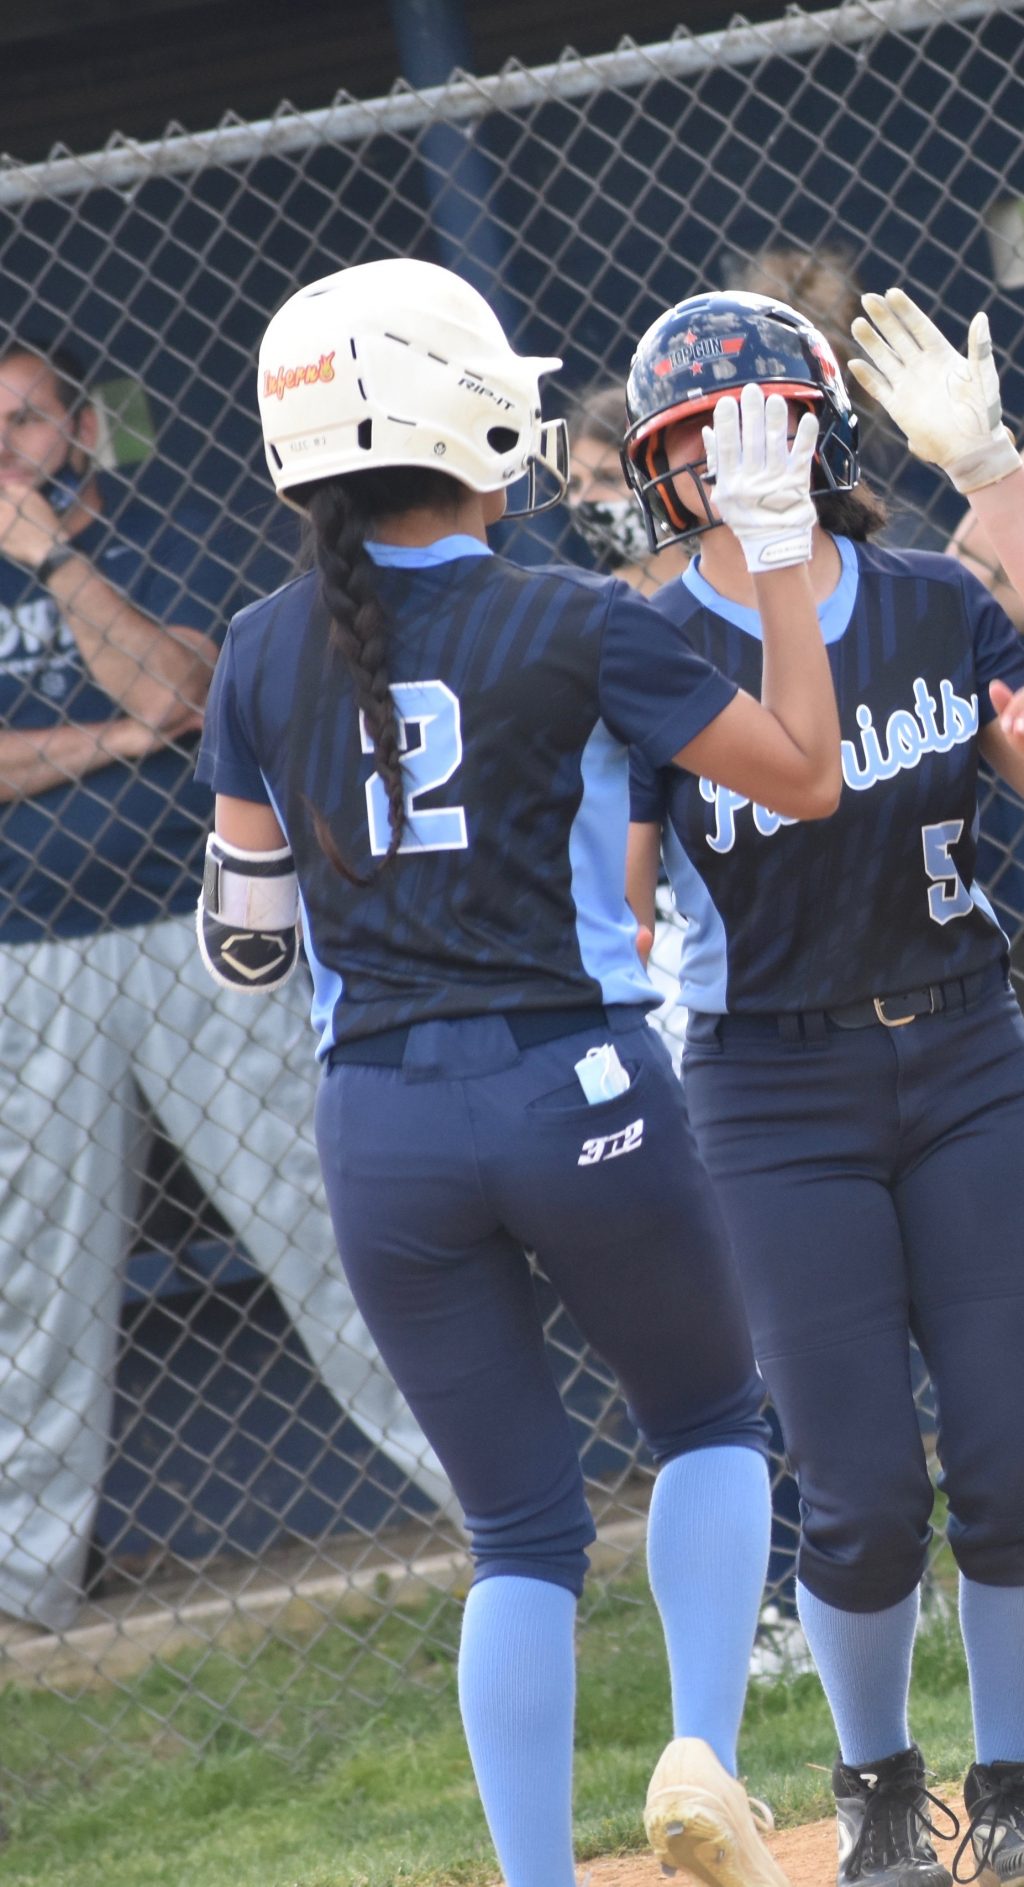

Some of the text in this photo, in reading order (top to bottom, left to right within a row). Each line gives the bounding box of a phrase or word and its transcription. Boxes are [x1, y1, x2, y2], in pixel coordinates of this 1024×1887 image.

[691, 336, 724, 360] GUN
[458, 378, 516, 411] RIP-IT
[358, 679, 469, 857] 2
[921, 818, 974, 926] 5
